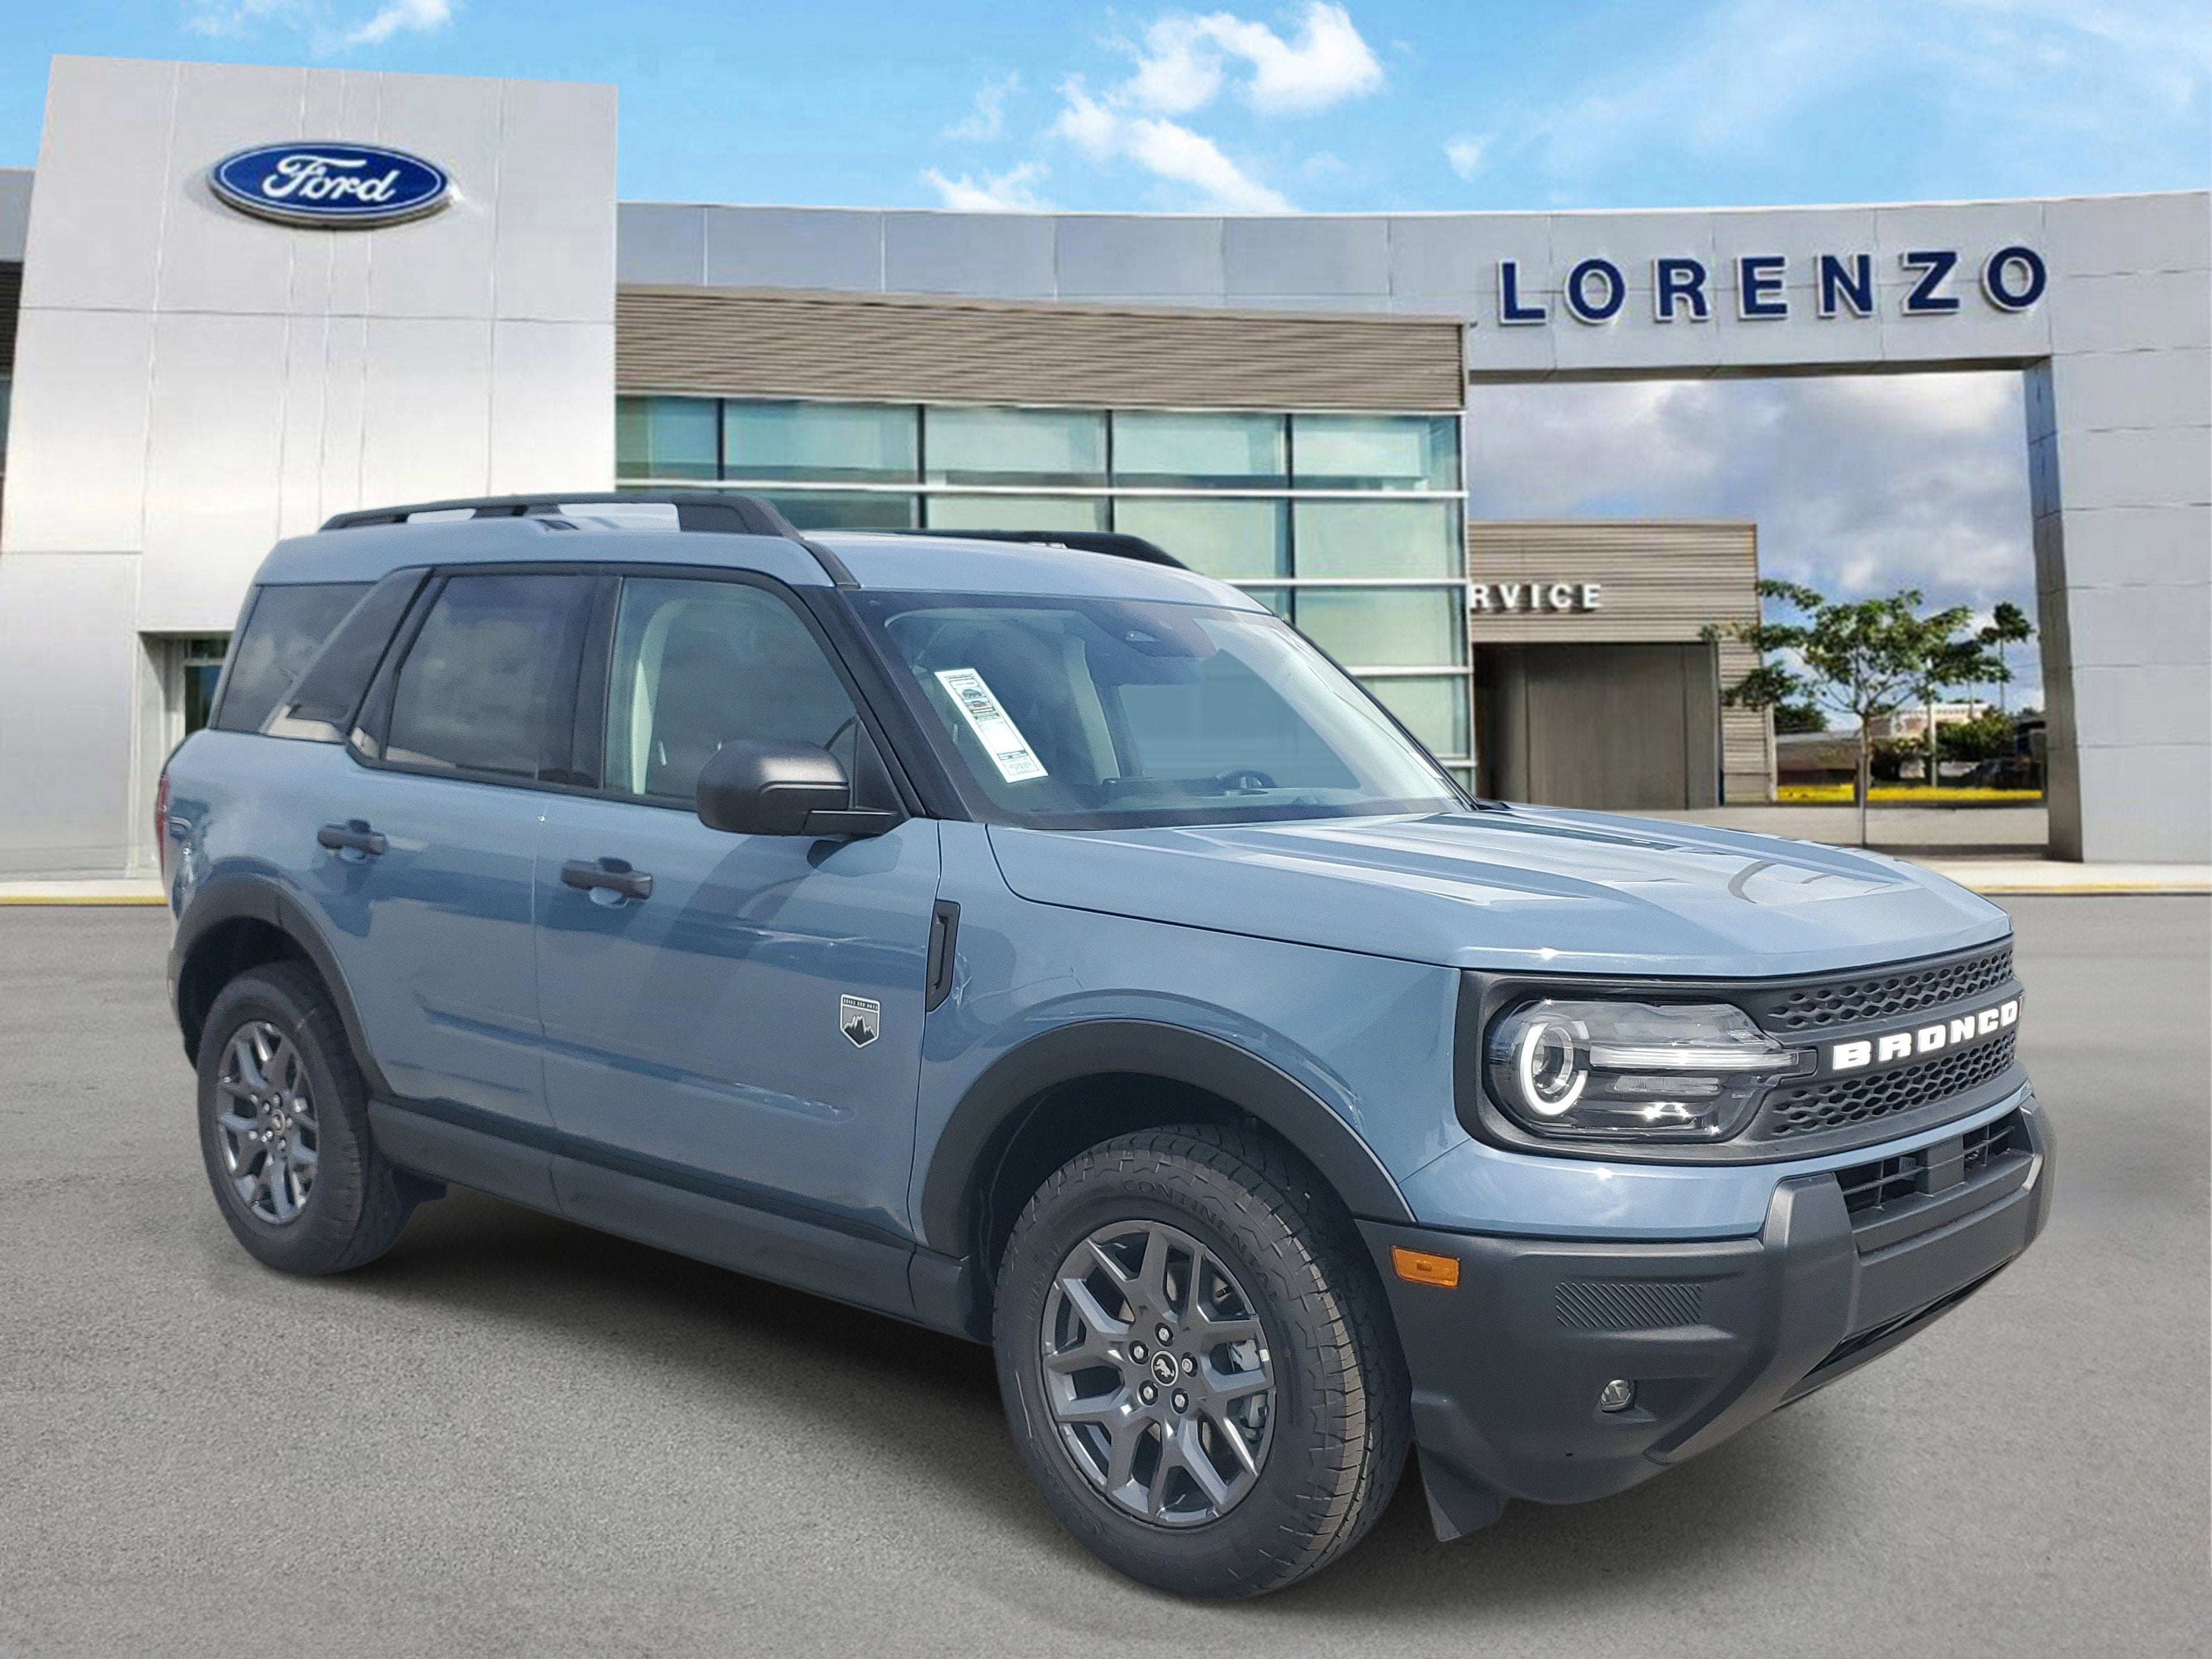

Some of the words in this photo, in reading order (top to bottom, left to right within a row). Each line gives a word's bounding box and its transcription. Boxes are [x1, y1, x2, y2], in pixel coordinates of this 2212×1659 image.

[262, 154, 401, 203] Ford
[1499, 245, 2047, 325] LORENZO
[1832, 1000, 2019, 1070] BRONCO
[1123, 1179, 1279, 1311] CONTINENTAL
